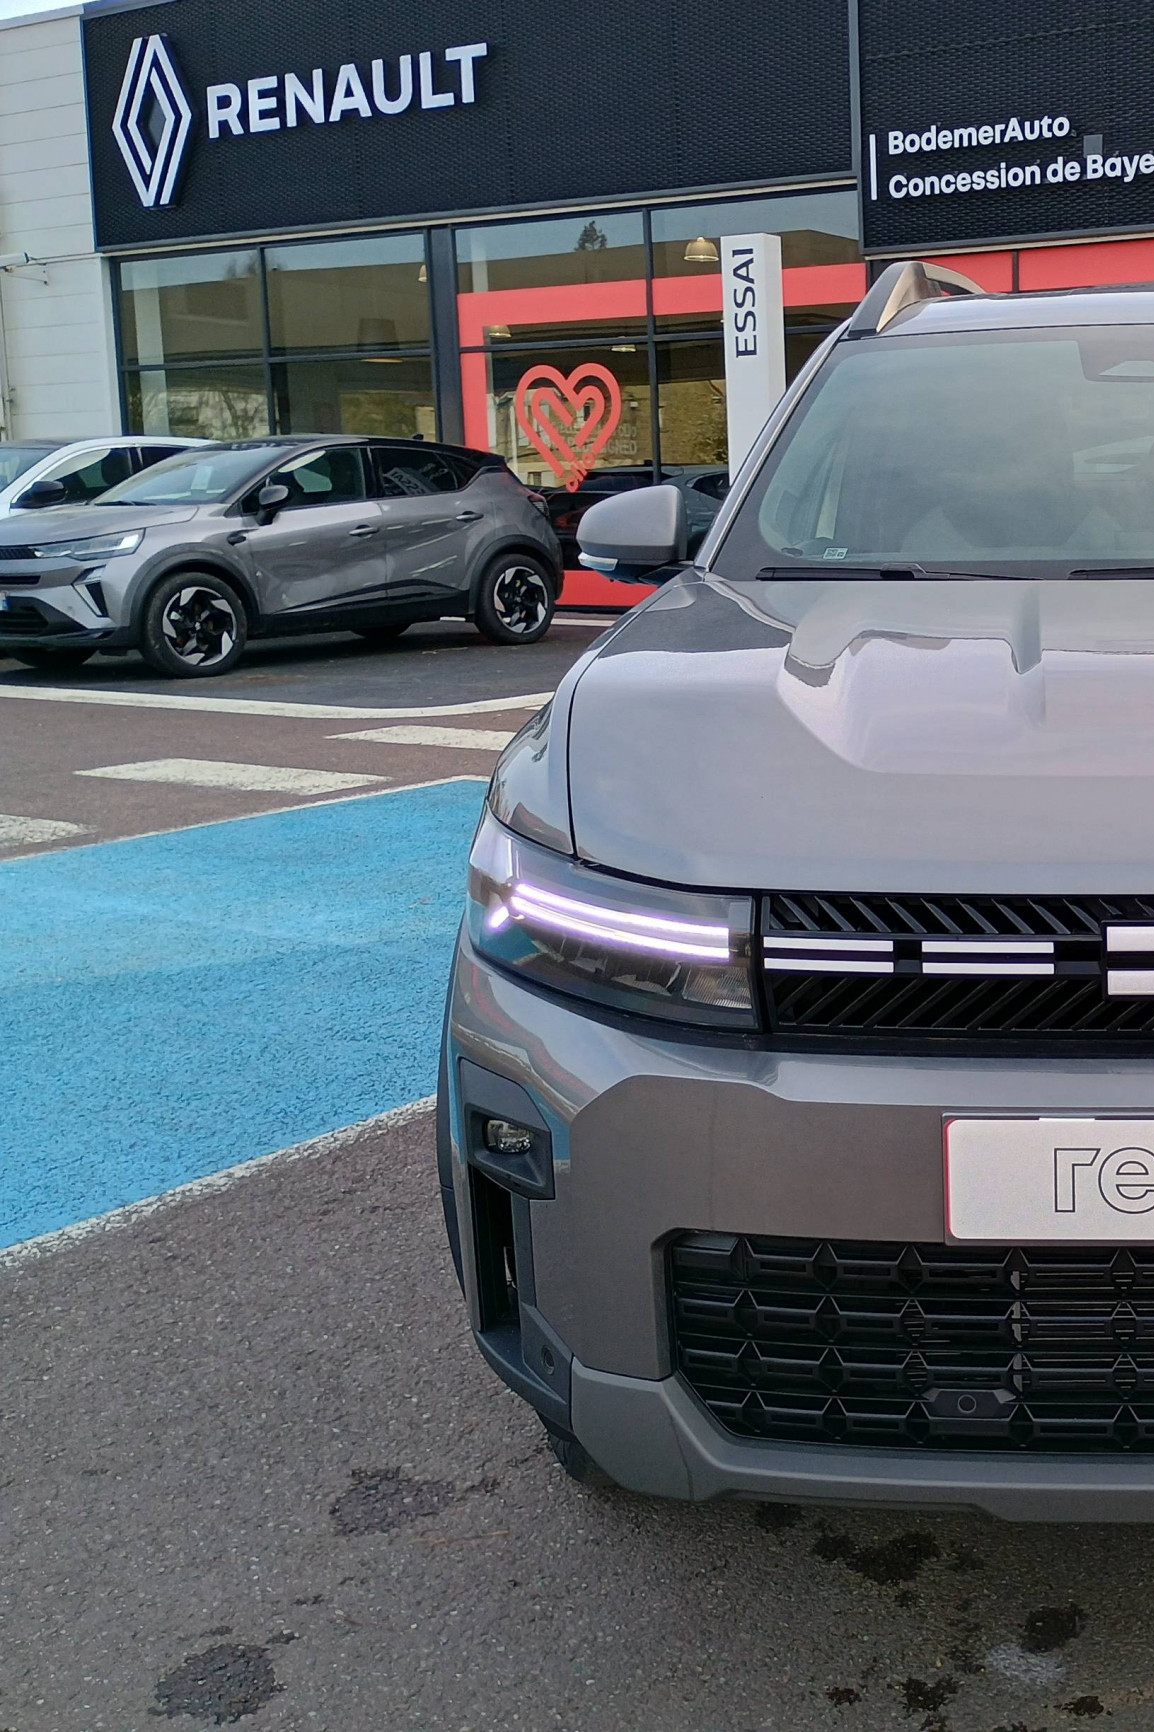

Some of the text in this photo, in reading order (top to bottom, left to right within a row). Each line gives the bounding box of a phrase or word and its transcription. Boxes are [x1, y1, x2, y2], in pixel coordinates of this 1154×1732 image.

[206, 42, 488, 139] RENAULT
[888, 115, 1070, 155] BodemerAuto
[888, 163, 1041, 199] Concession
[1046, 157, 1082, 184] de
[732, 248, 757, 358] ESSAI
